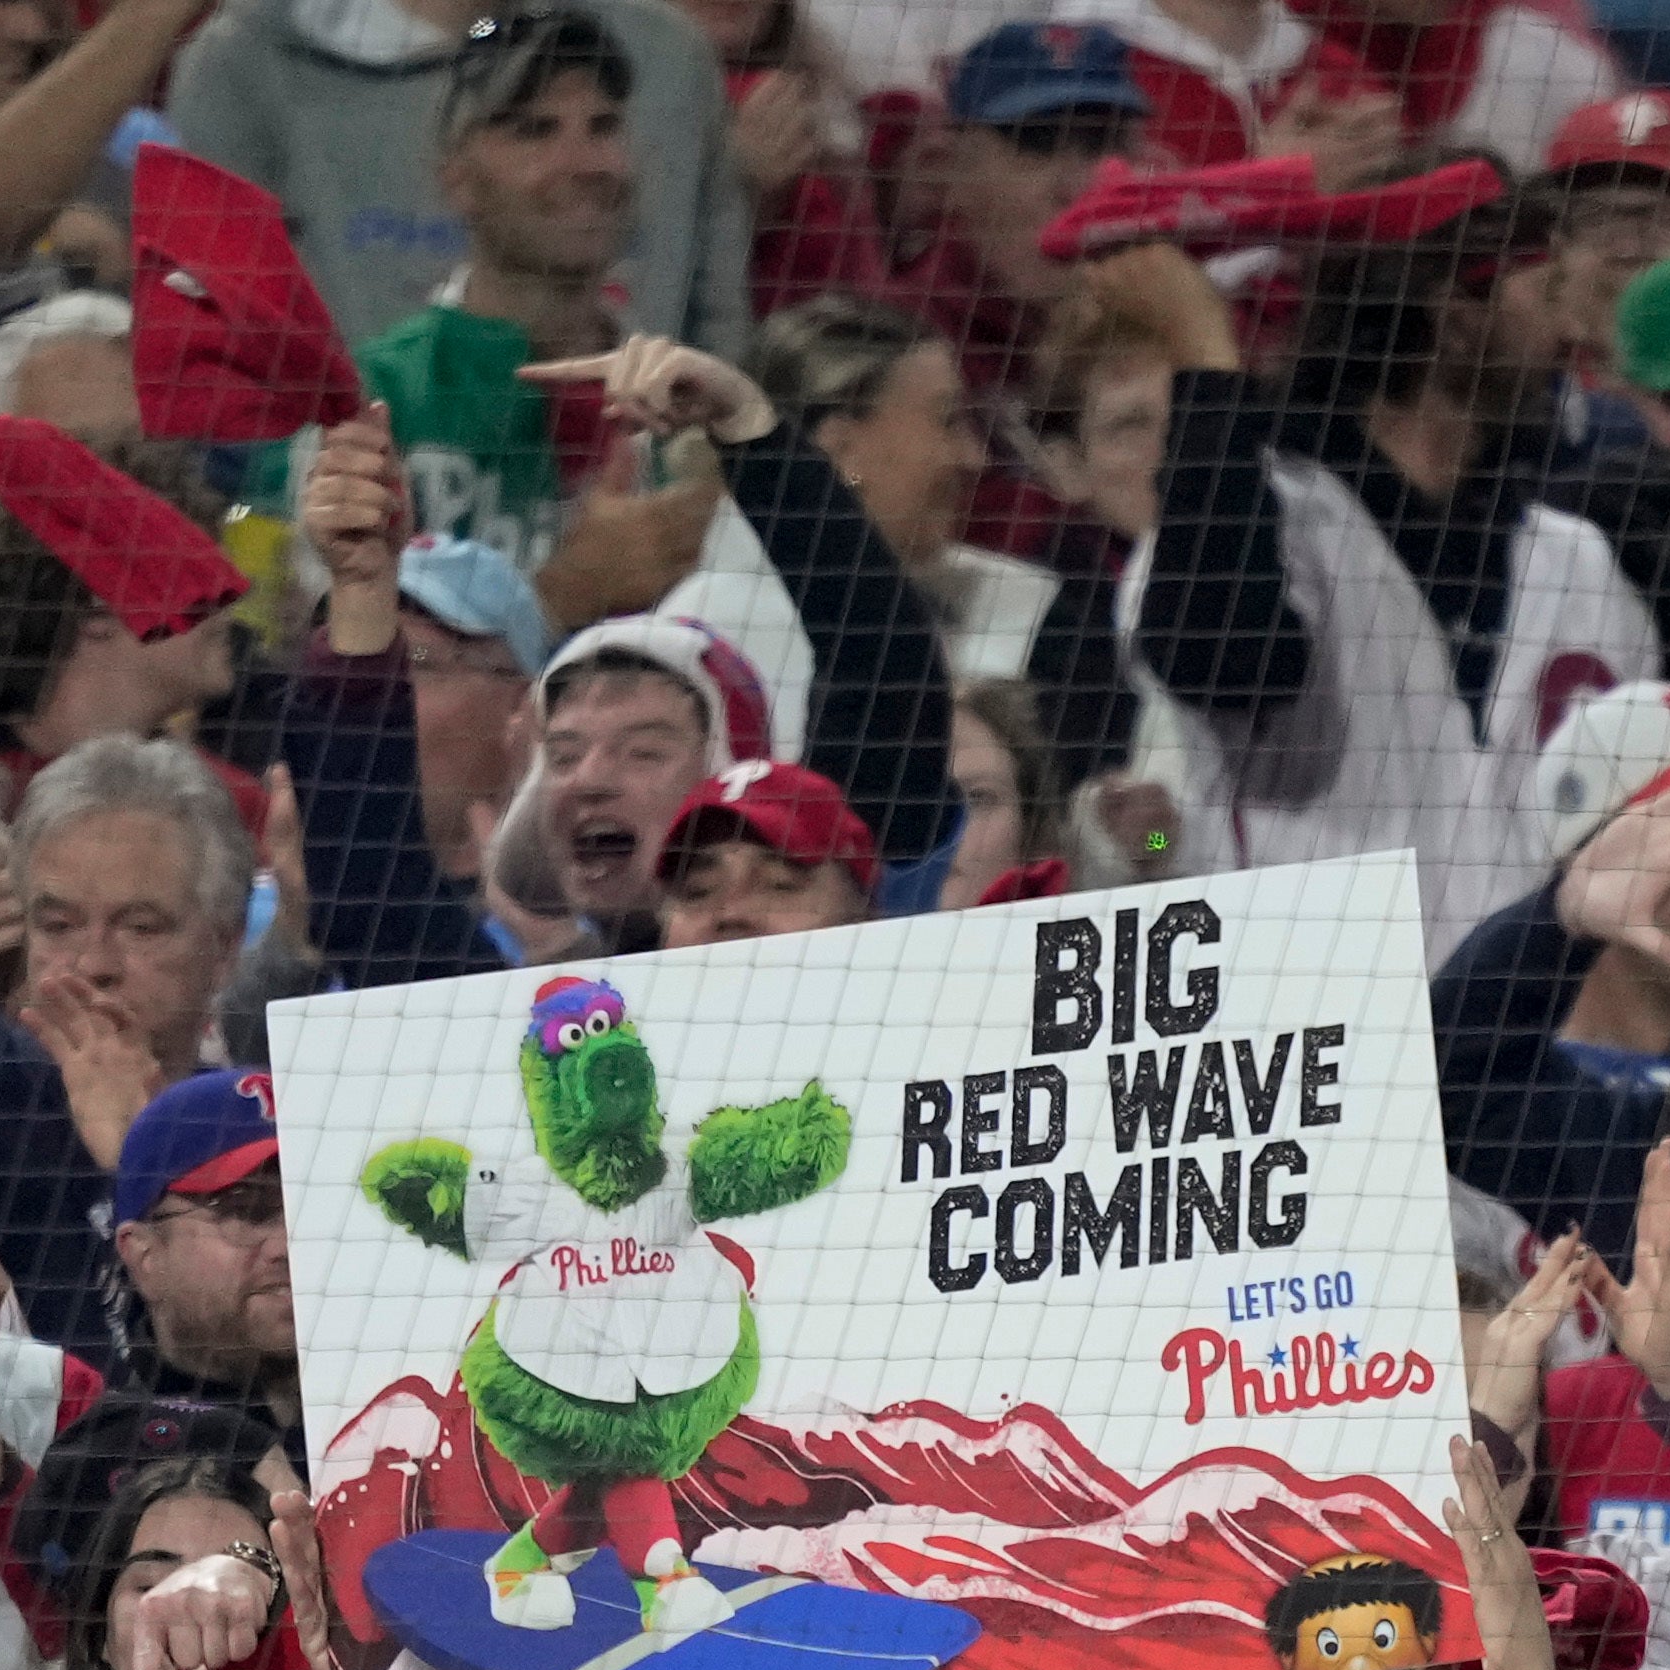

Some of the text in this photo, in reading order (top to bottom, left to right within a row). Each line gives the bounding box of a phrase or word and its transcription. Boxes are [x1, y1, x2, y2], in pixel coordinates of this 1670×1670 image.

[1031, 899, 1220, 1056] BIG
[900, 1024, 1345, 1184] RED WAVE
[550, 1242, 676, 1292] Phillies
[929, 1140, 1309, 1294] COMING
[1226, 1270, 1355, 1323] LET'S GO
[1161, 1326, 1435, 1425] Phillies
